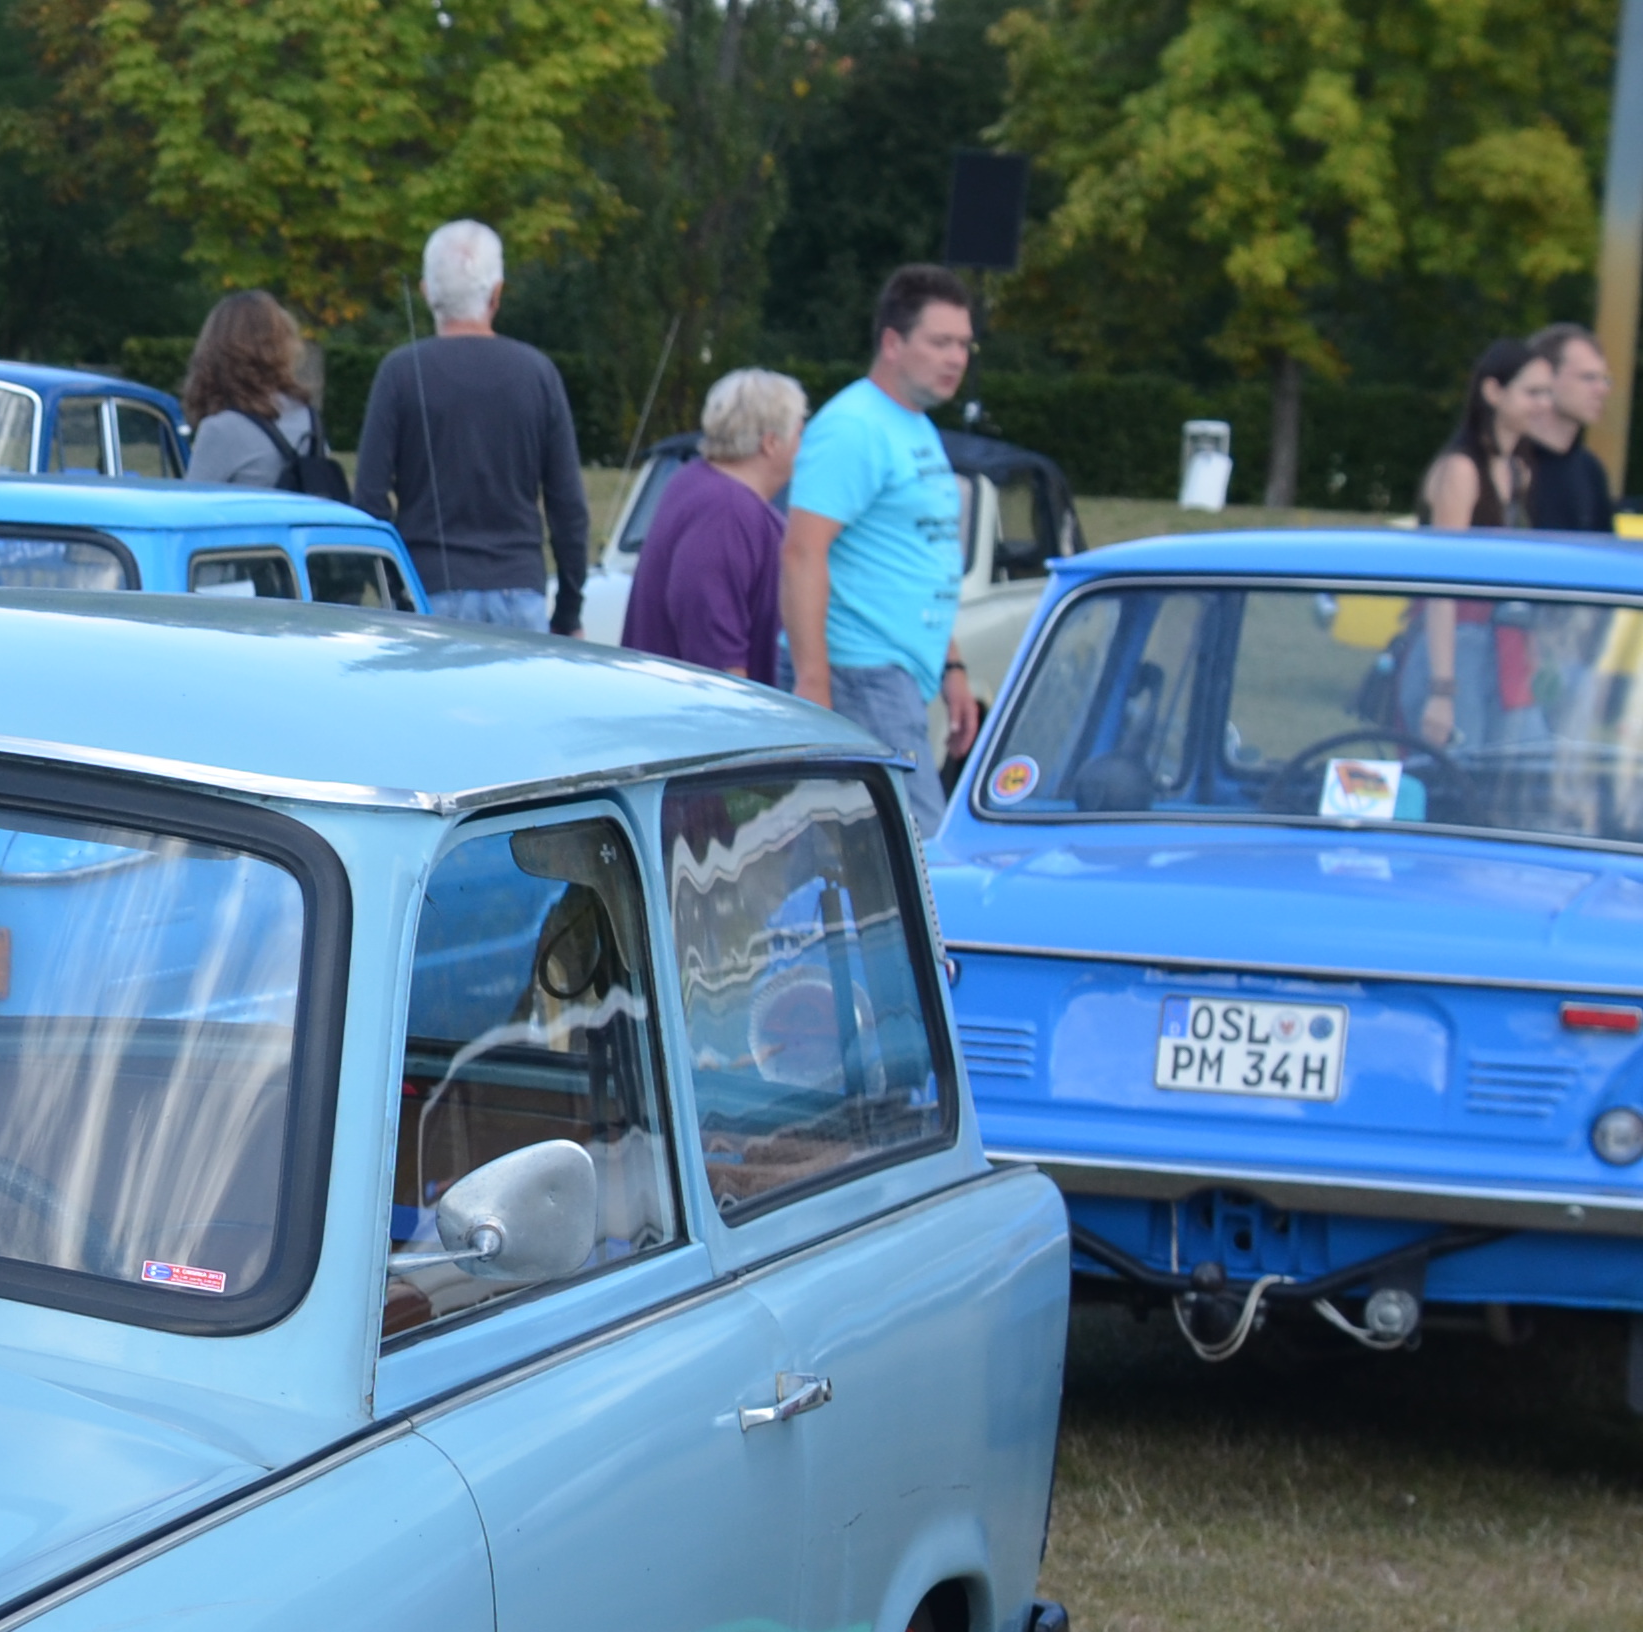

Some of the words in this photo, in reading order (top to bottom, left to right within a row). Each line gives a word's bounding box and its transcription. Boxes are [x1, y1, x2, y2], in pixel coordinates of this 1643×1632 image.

[1191, 1003, 1271, 1045] OSL
[1171, 1044, 1225, 1085] PM
[1243, 1050, 1327, 1092] 34H
